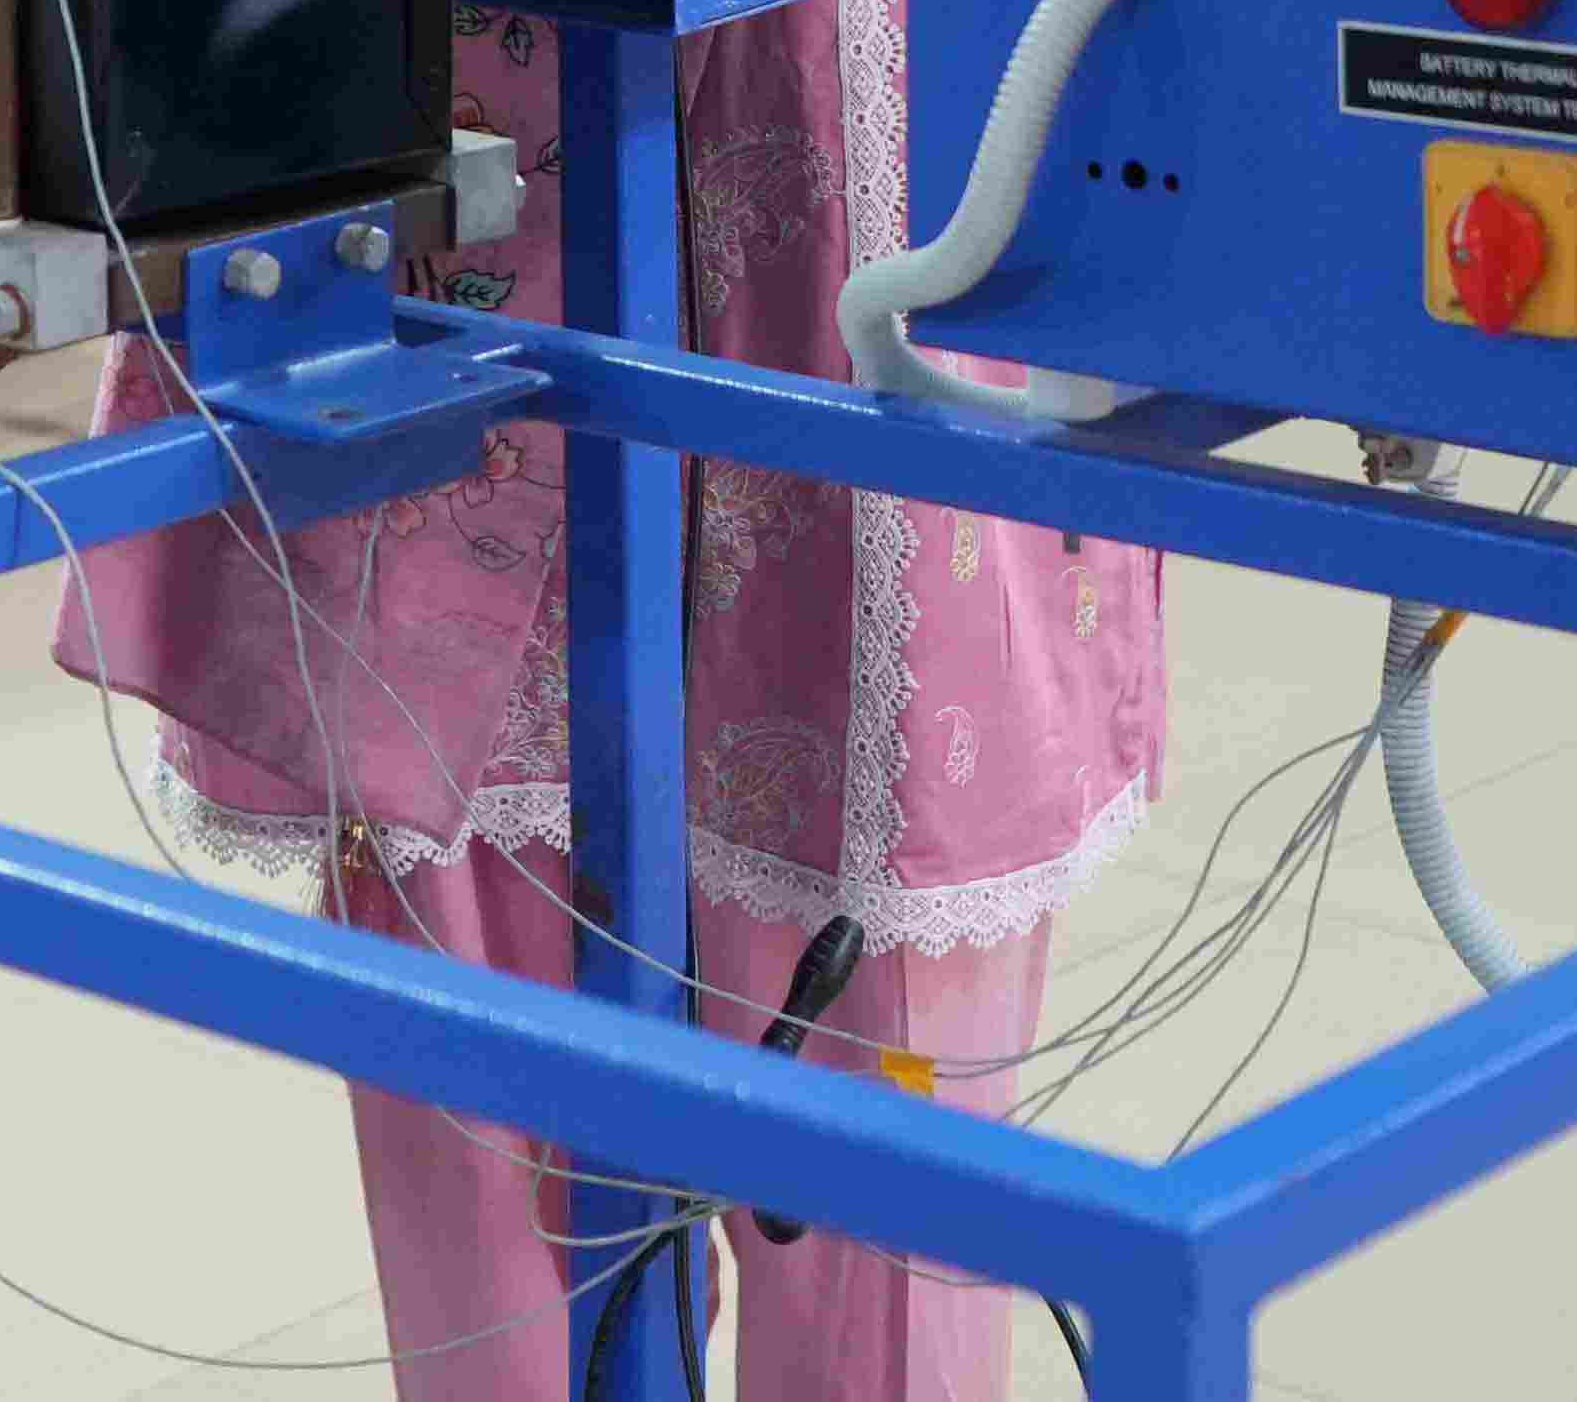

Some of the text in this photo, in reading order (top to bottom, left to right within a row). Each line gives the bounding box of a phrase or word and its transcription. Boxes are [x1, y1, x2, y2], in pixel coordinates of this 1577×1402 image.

[1420, 52, 1495, 80] BATTERY
[1367, 78, 1487, 111] MANAGEMENT
[1489, 92, 1560, 117] SYSTEM
